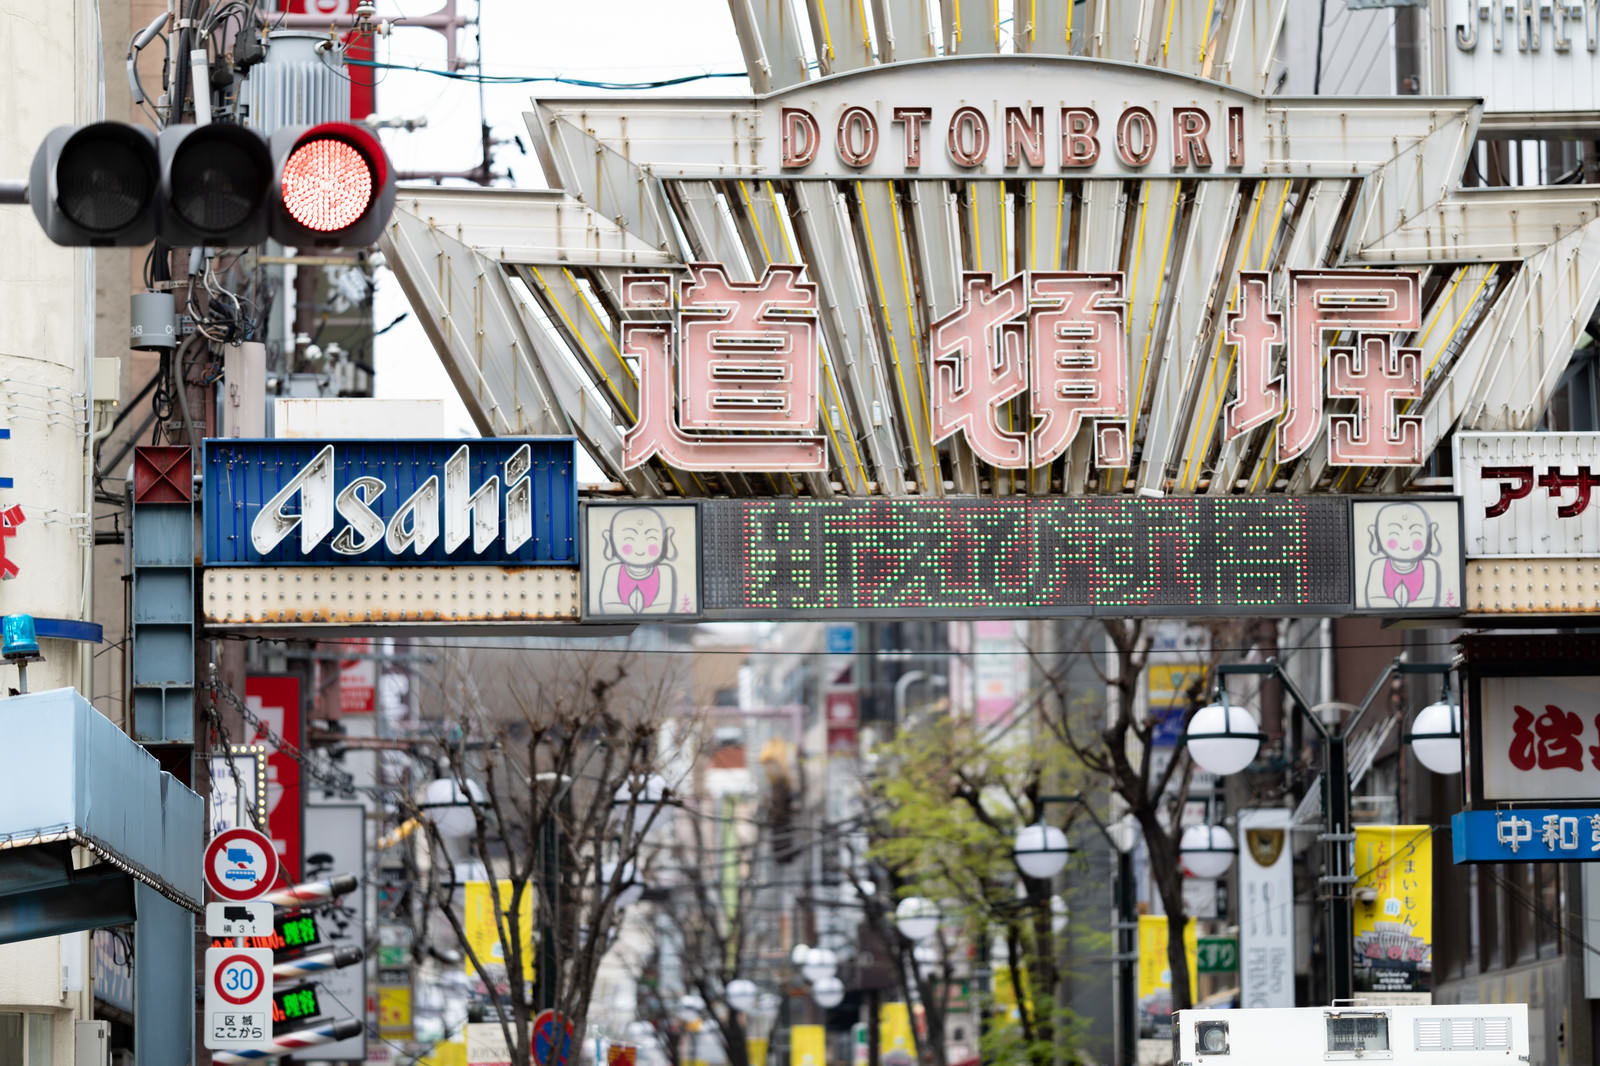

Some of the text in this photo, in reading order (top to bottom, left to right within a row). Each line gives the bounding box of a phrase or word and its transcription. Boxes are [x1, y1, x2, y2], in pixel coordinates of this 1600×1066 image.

[780, 105, 1245, 170] DOTONBORI
[619, 262, 1426, 471] 道頓堀
[250, 443, 534, 556] Asahi
[1480, 465, 1600, 519] アサ
[1496, 813, 1600, 854] 中和
[226, 968, 254, 991] 30
[215, 1027, 263, 1039] ここから
[225, 1015, 254, 1026] 区域
